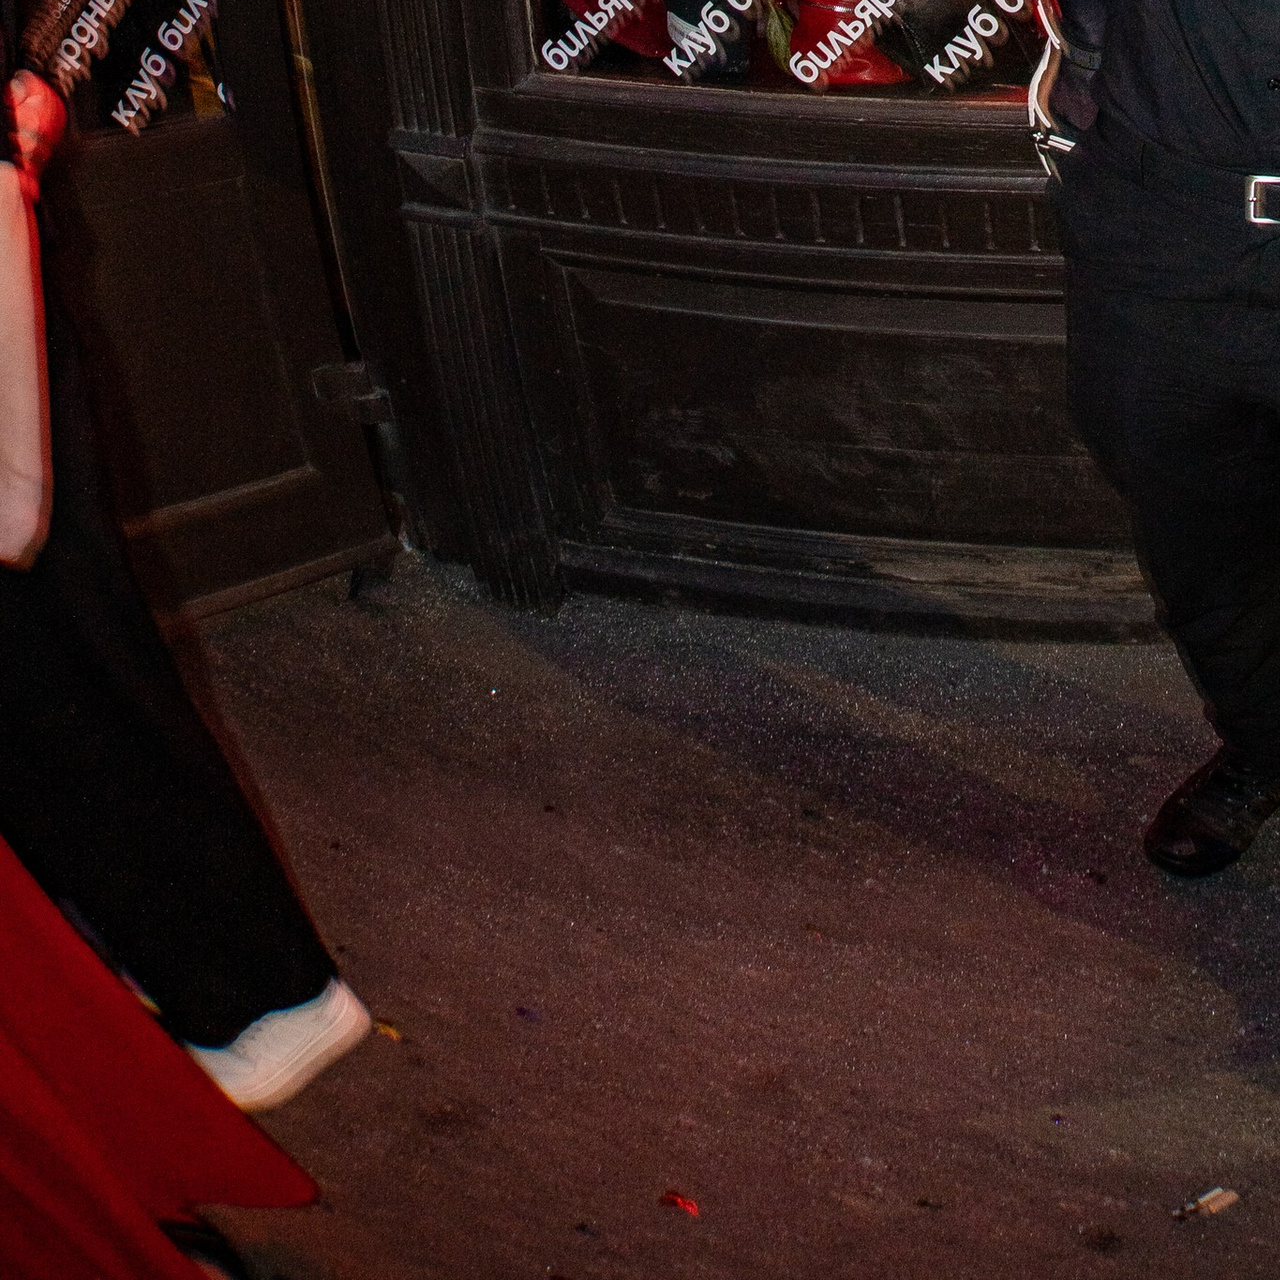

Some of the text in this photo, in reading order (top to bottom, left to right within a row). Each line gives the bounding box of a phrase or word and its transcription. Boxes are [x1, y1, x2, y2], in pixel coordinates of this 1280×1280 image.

[662, 0, 731, 77] клуб
[924, 4, 999, 84] клуб
[111, 47, 167, 127] клуб
